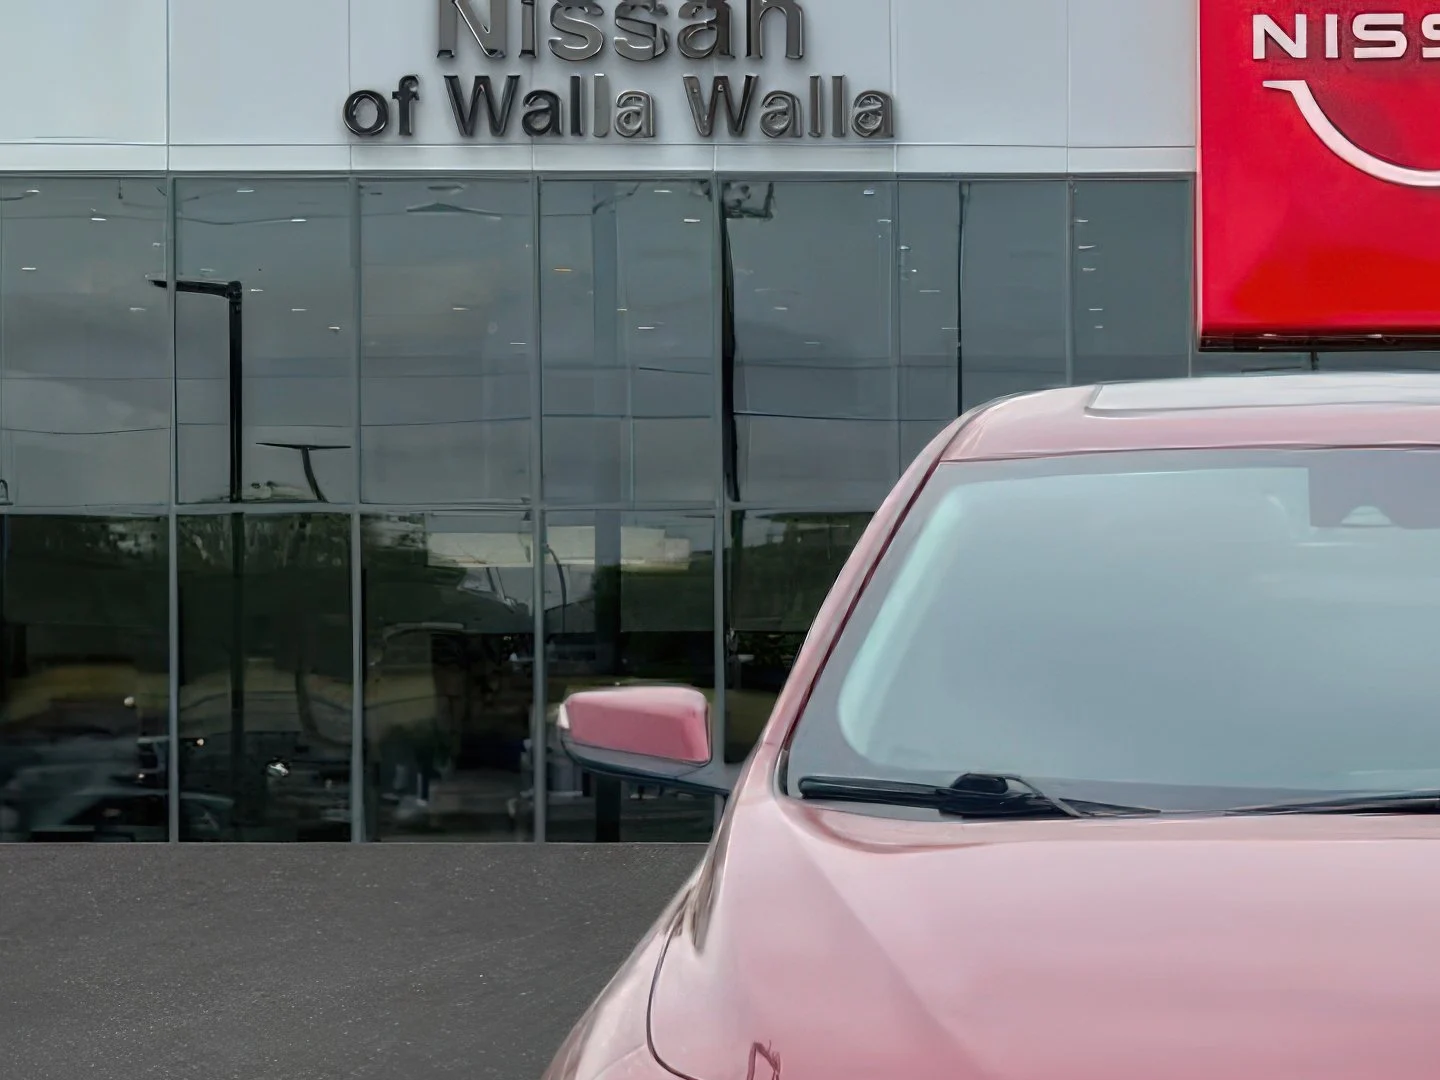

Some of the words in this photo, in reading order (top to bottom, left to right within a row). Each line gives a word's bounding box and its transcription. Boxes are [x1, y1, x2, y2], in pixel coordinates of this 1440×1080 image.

[435, 0, 808, 61] Nissan
[343, 75, 420, 136] of
[444, 75, 654, 138] Walla
[682, 75, 893, 138] Walla
